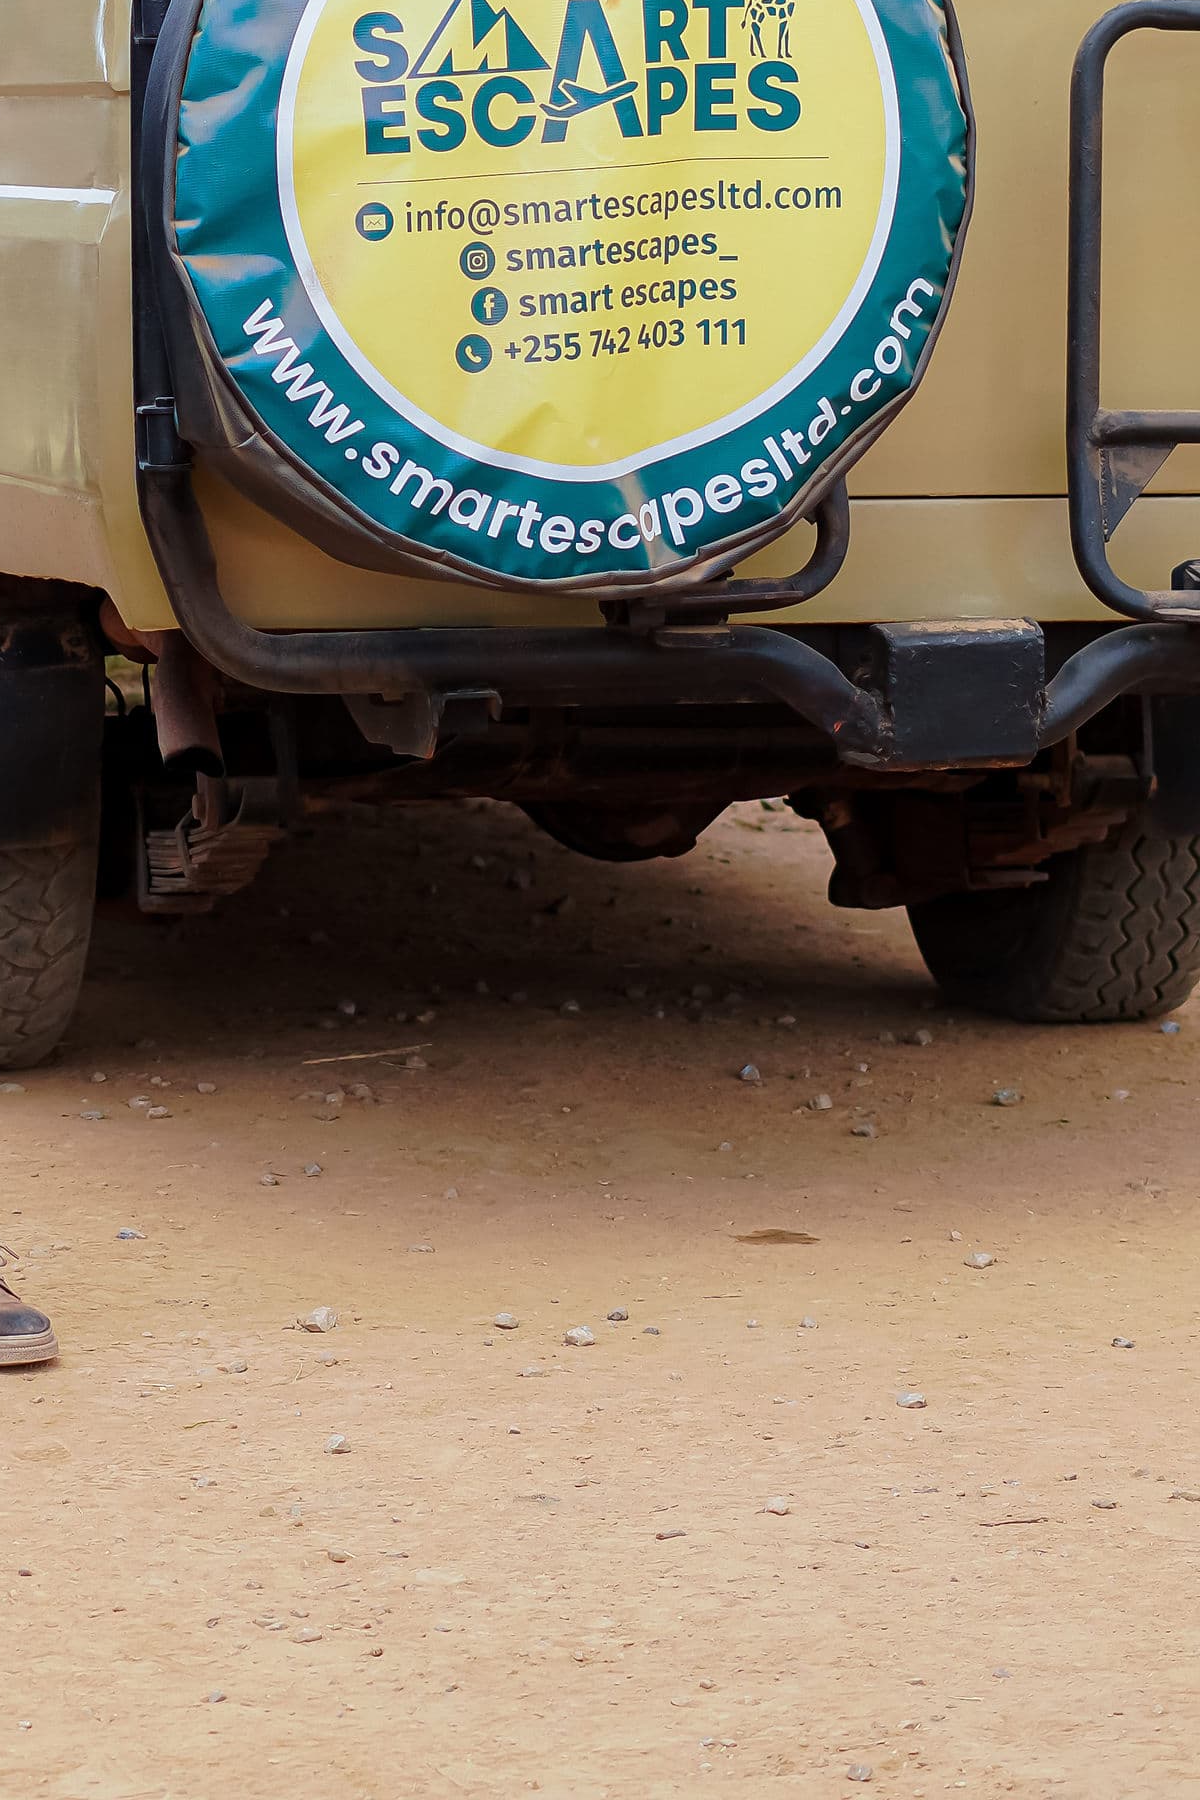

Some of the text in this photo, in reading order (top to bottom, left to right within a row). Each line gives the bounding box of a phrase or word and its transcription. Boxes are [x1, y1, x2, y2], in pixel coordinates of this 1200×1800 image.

[361, 61, 802, 156] ESCAPES
[405, 180, 843, 236] info@smartescapesltd.com
[506, 230, 738, 272] smartescapes_
[519, 274, 737, 318] smart escapes
[504, 318, 747, 365] +255 742 403 111
[241, 276, 934, 555] www.smartescapesltd.com
